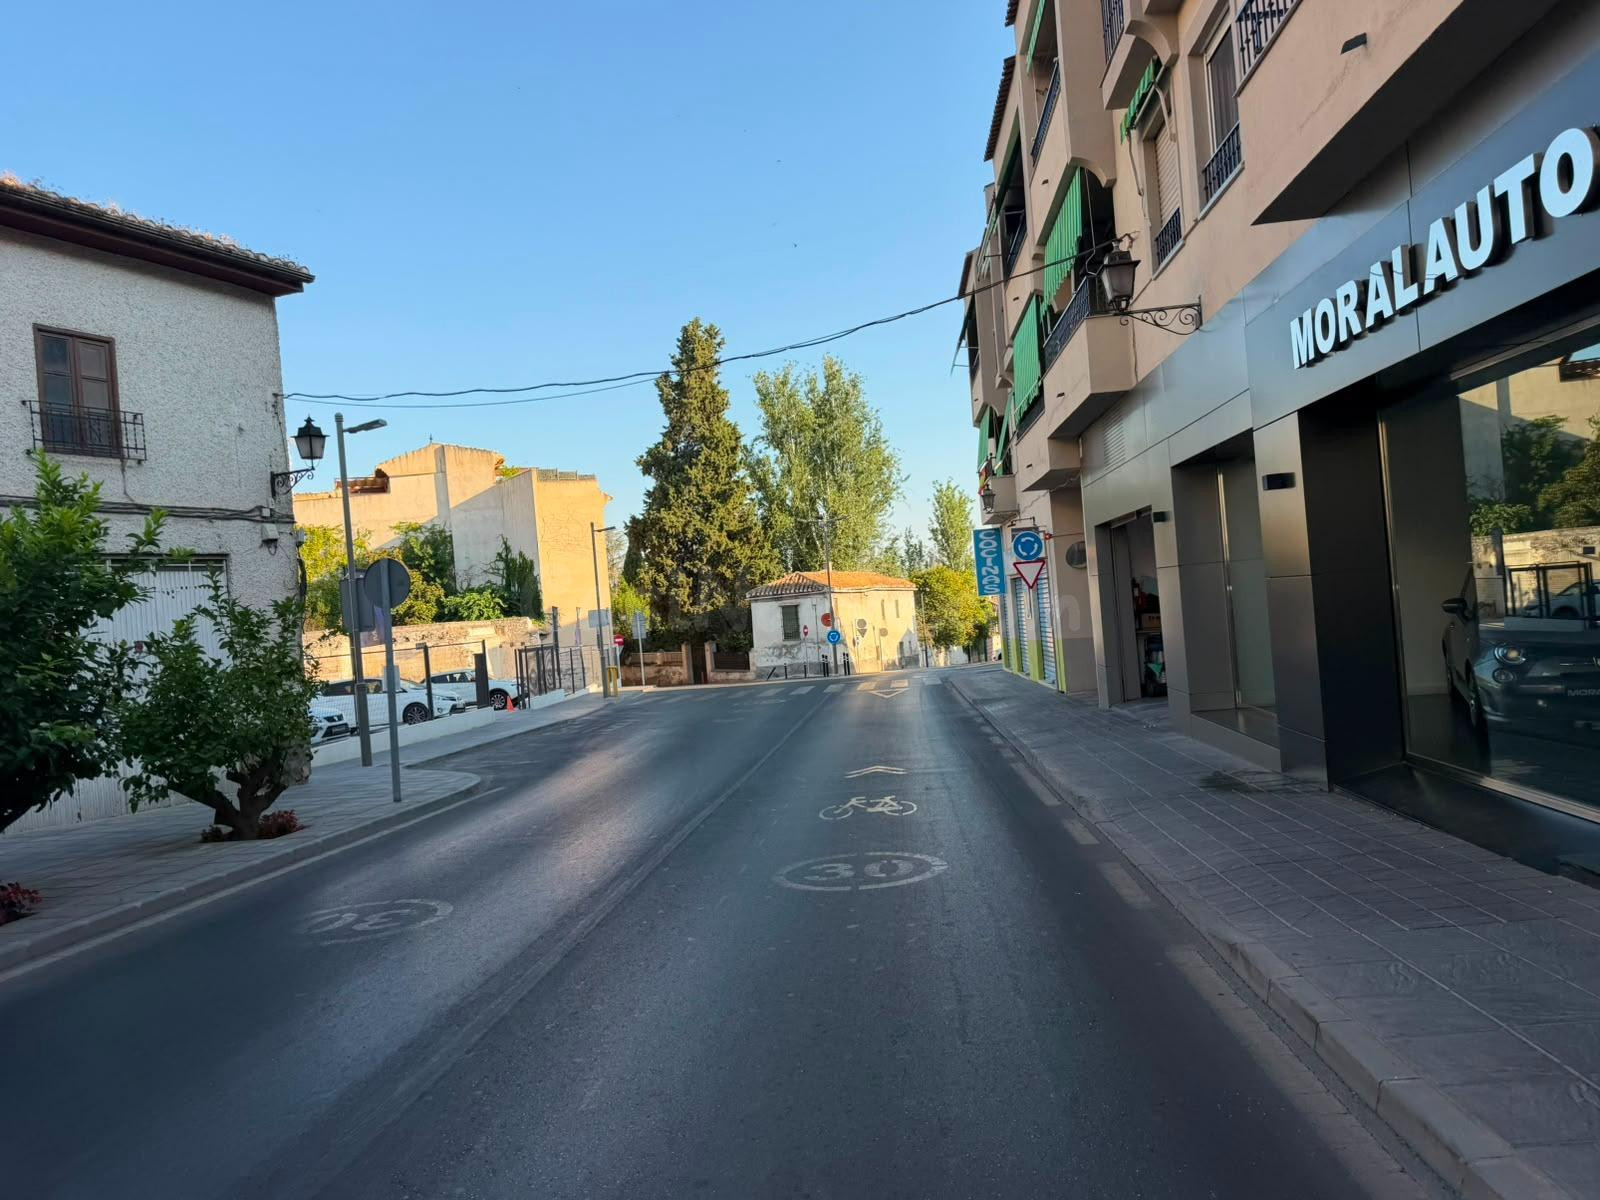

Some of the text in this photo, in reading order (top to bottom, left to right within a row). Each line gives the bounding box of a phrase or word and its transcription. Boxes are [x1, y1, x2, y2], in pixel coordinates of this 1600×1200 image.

[1290, 127, 1596, 369] MORALAUTO
[978, 530, 1001, 594] COCINAS
[803, 859, 913, 881] 30
